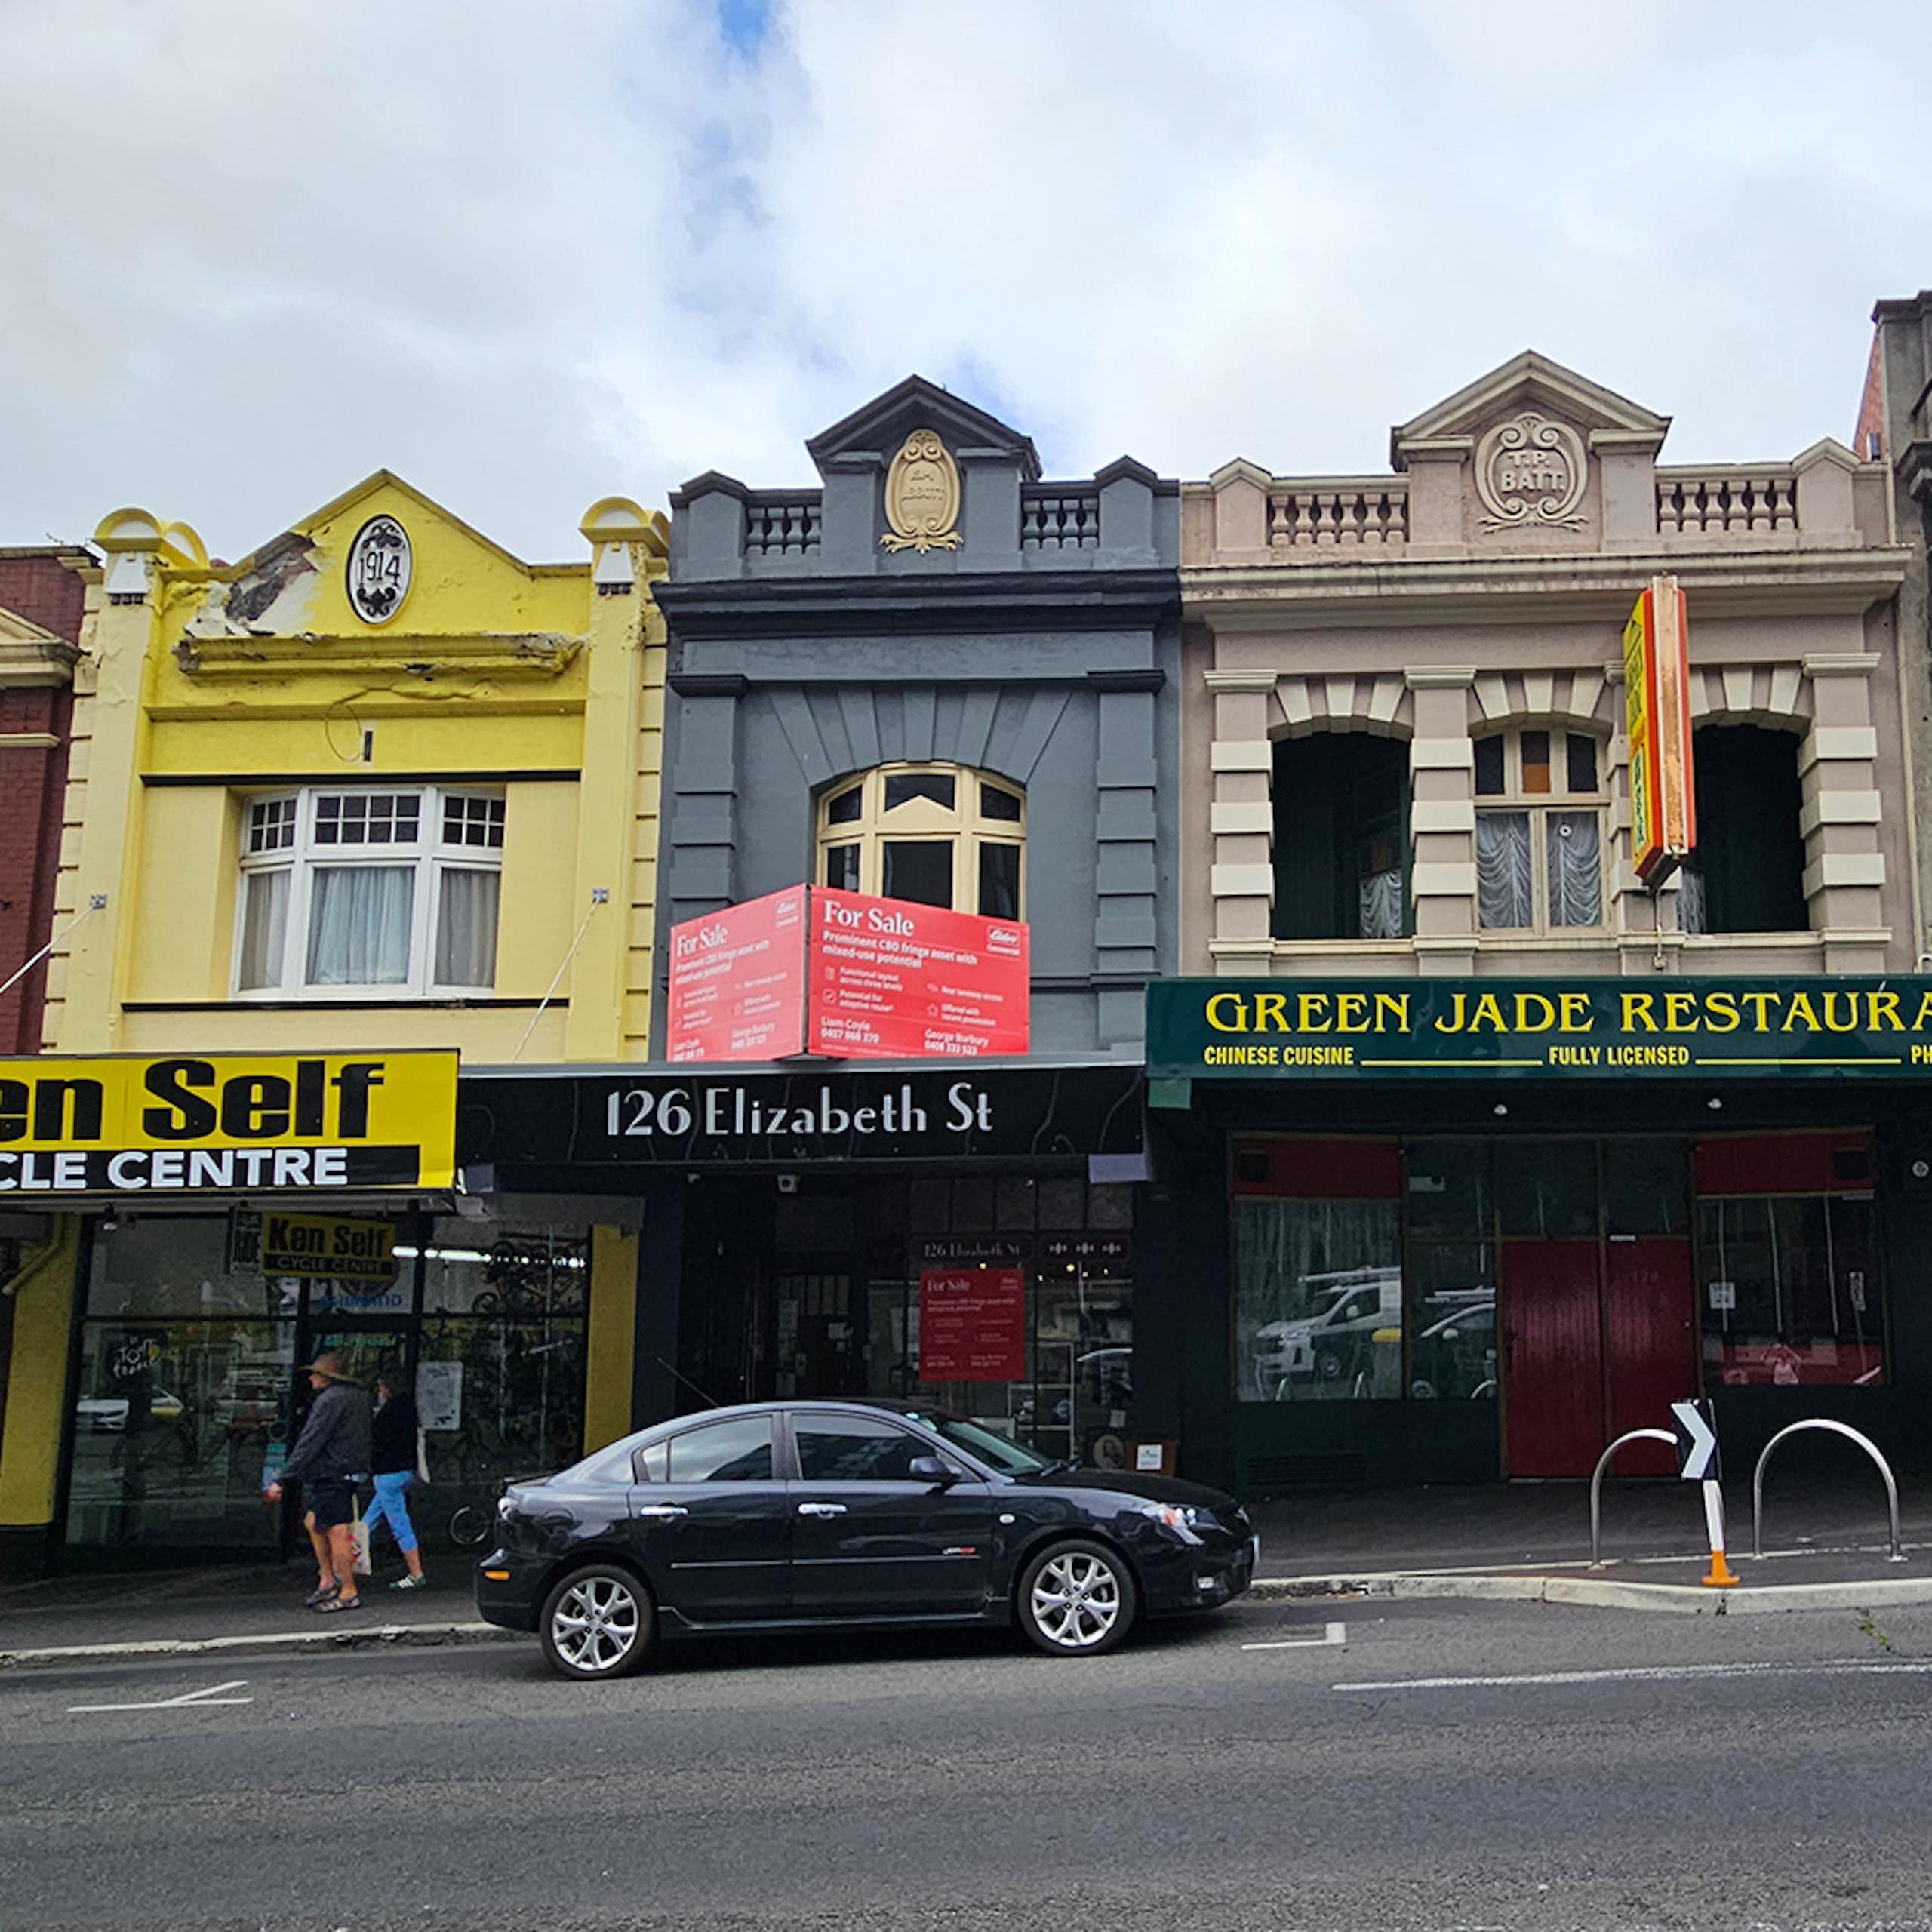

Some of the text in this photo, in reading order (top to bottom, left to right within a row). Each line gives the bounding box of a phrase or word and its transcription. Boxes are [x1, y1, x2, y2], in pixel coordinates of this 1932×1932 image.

[1507, 450, 1550, 467] T.P.
[1500, 470, 1565, 492] BATT.
[359, 552, 401, 589] 1914
[823, 900, 863, 927] For
[868, 908, 915, 937] Sale
[676, 923, 728, 958] For Sale
[1205, 992, 1411, 1033] GREEN
[1434, 992, 1595, 1033] JADE
[1204, 1046, 1280, 1066] CHINESE
[1283, 1046, 1355, 1066] CUISINE
[1549, 1045, 1601, 1066] FULLY
[1607, 1045, 1690, 1066] LICENSED
[143, 1060, 385, 1140] Self
[607, 1082, 993, 1136] 126 Elizabeth St
[107, 1148, 348, 1188] CENTRE
[267, 1217, 325, 1254] Ken
[333, 1224, 390, 1257] Self
[277, 1256, 325, 1271] CYCLE
